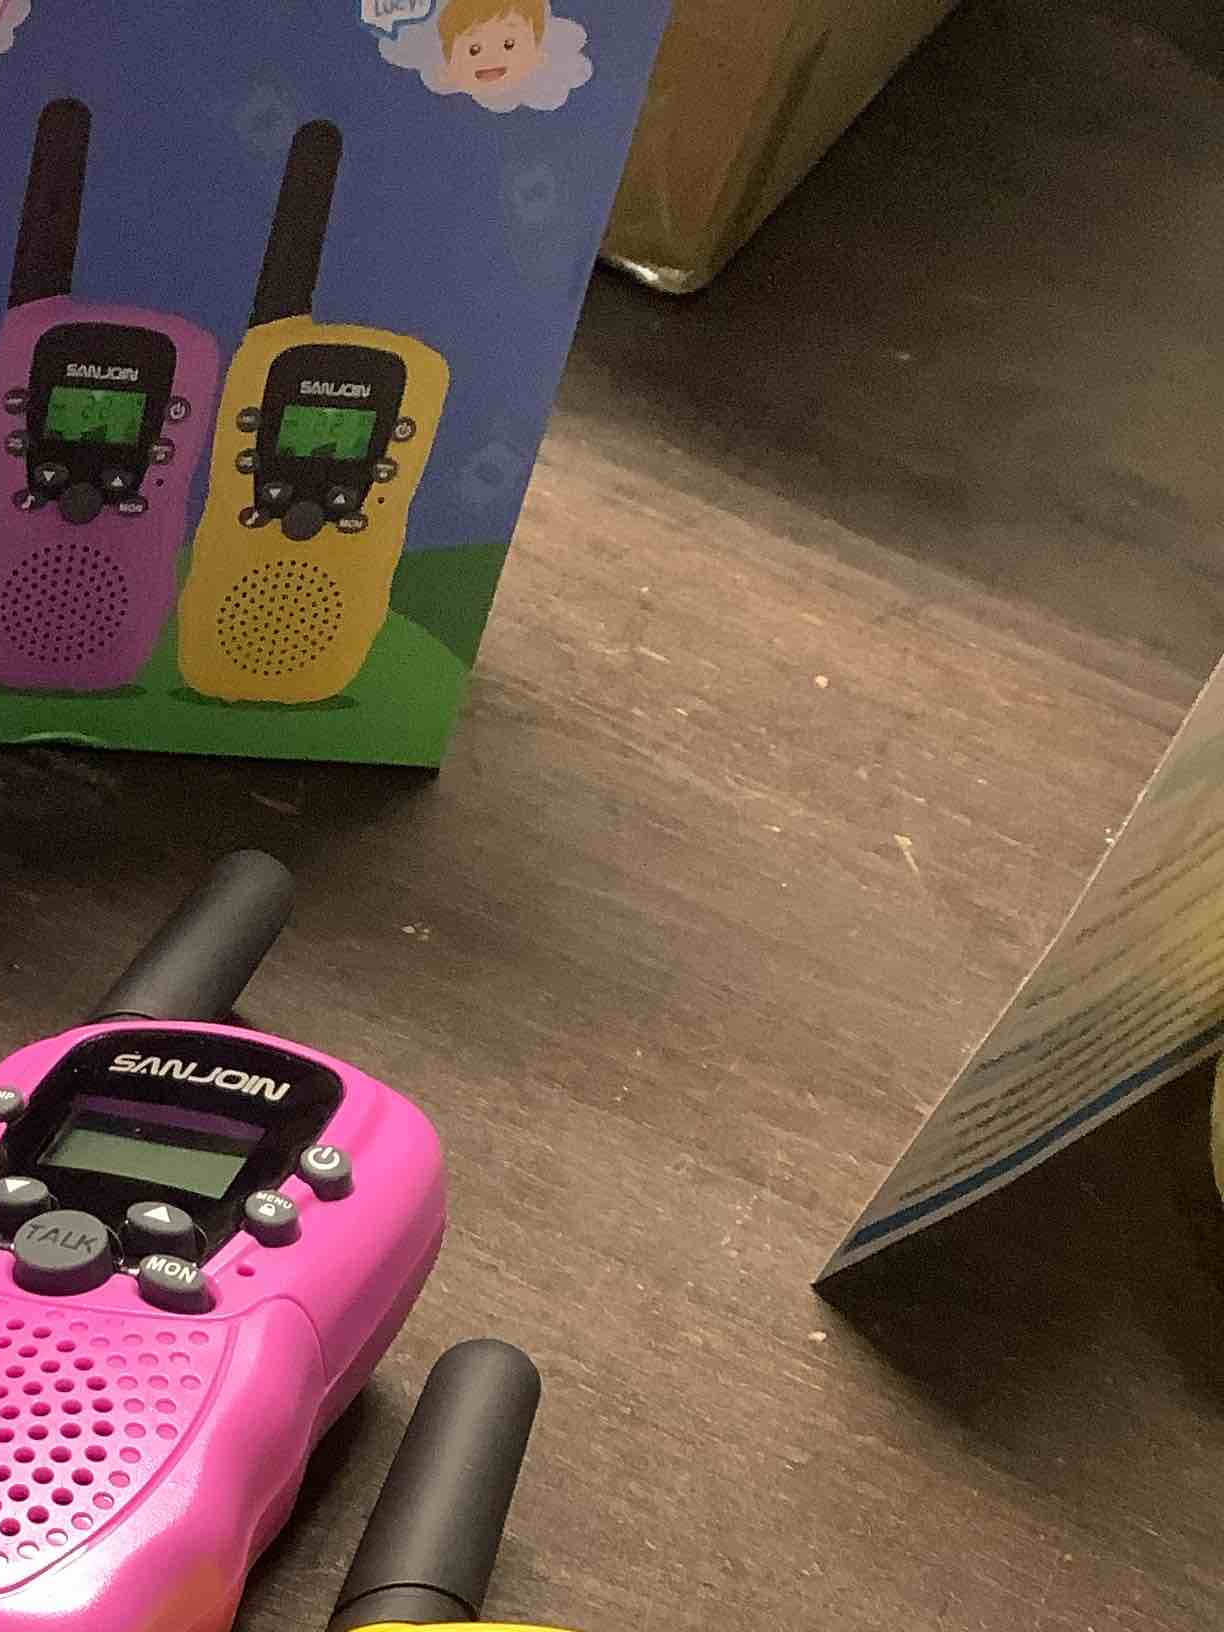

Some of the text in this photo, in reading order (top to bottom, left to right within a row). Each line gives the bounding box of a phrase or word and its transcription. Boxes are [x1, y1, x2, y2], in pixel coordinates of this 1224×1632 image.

[109, 1052, 290, 1102] SANJOIN
[255, 1191, 293, 1209] MENU
[23, 1222, 97, 1256] TALK
[146, 1254, 198, 1285] MON
